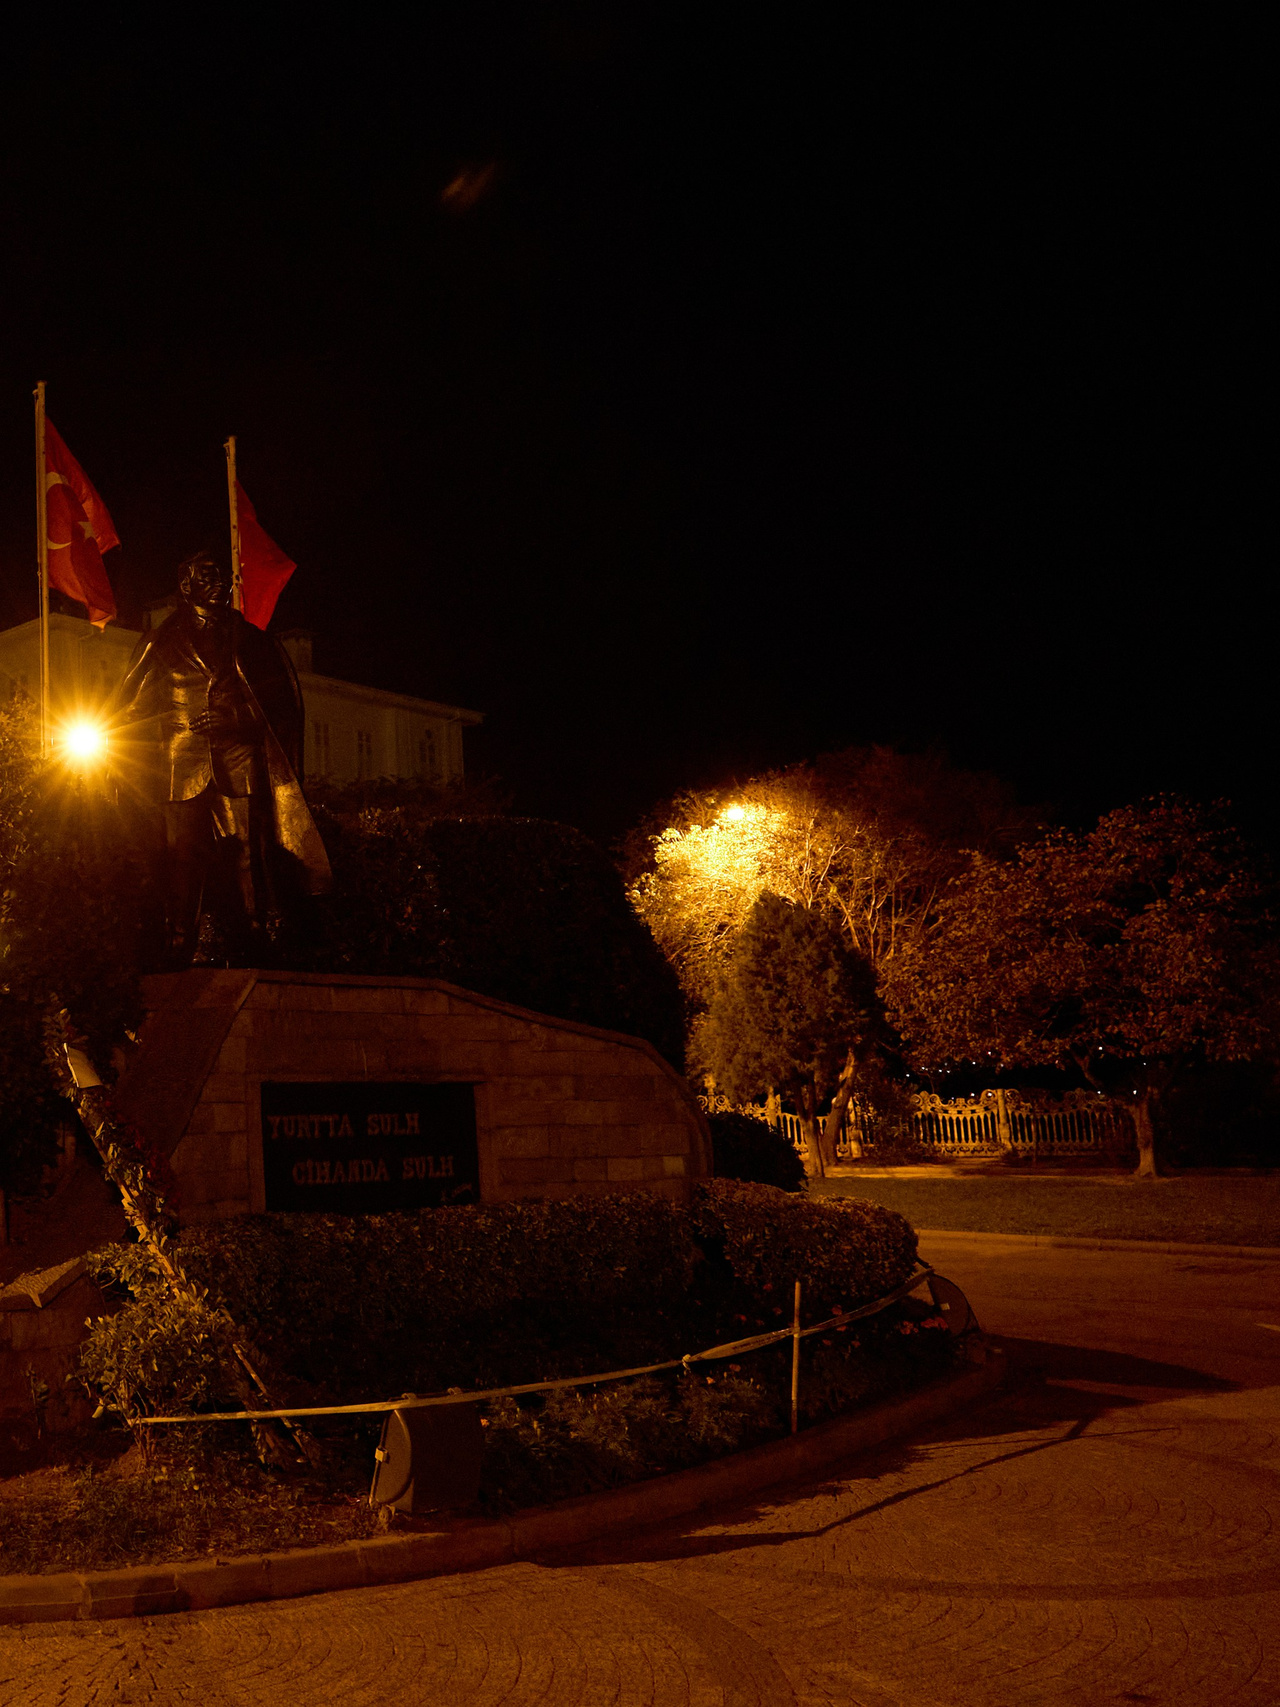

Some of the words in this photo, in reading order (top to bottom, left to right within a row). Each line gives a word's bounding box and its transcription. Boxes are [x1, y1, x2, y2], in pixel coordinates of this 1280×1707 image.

[266, 1113, 355, 1139] YURTTA
[366, 1112, 421, 1136] SULH
[401, 1154, 455, 1180] SULH
